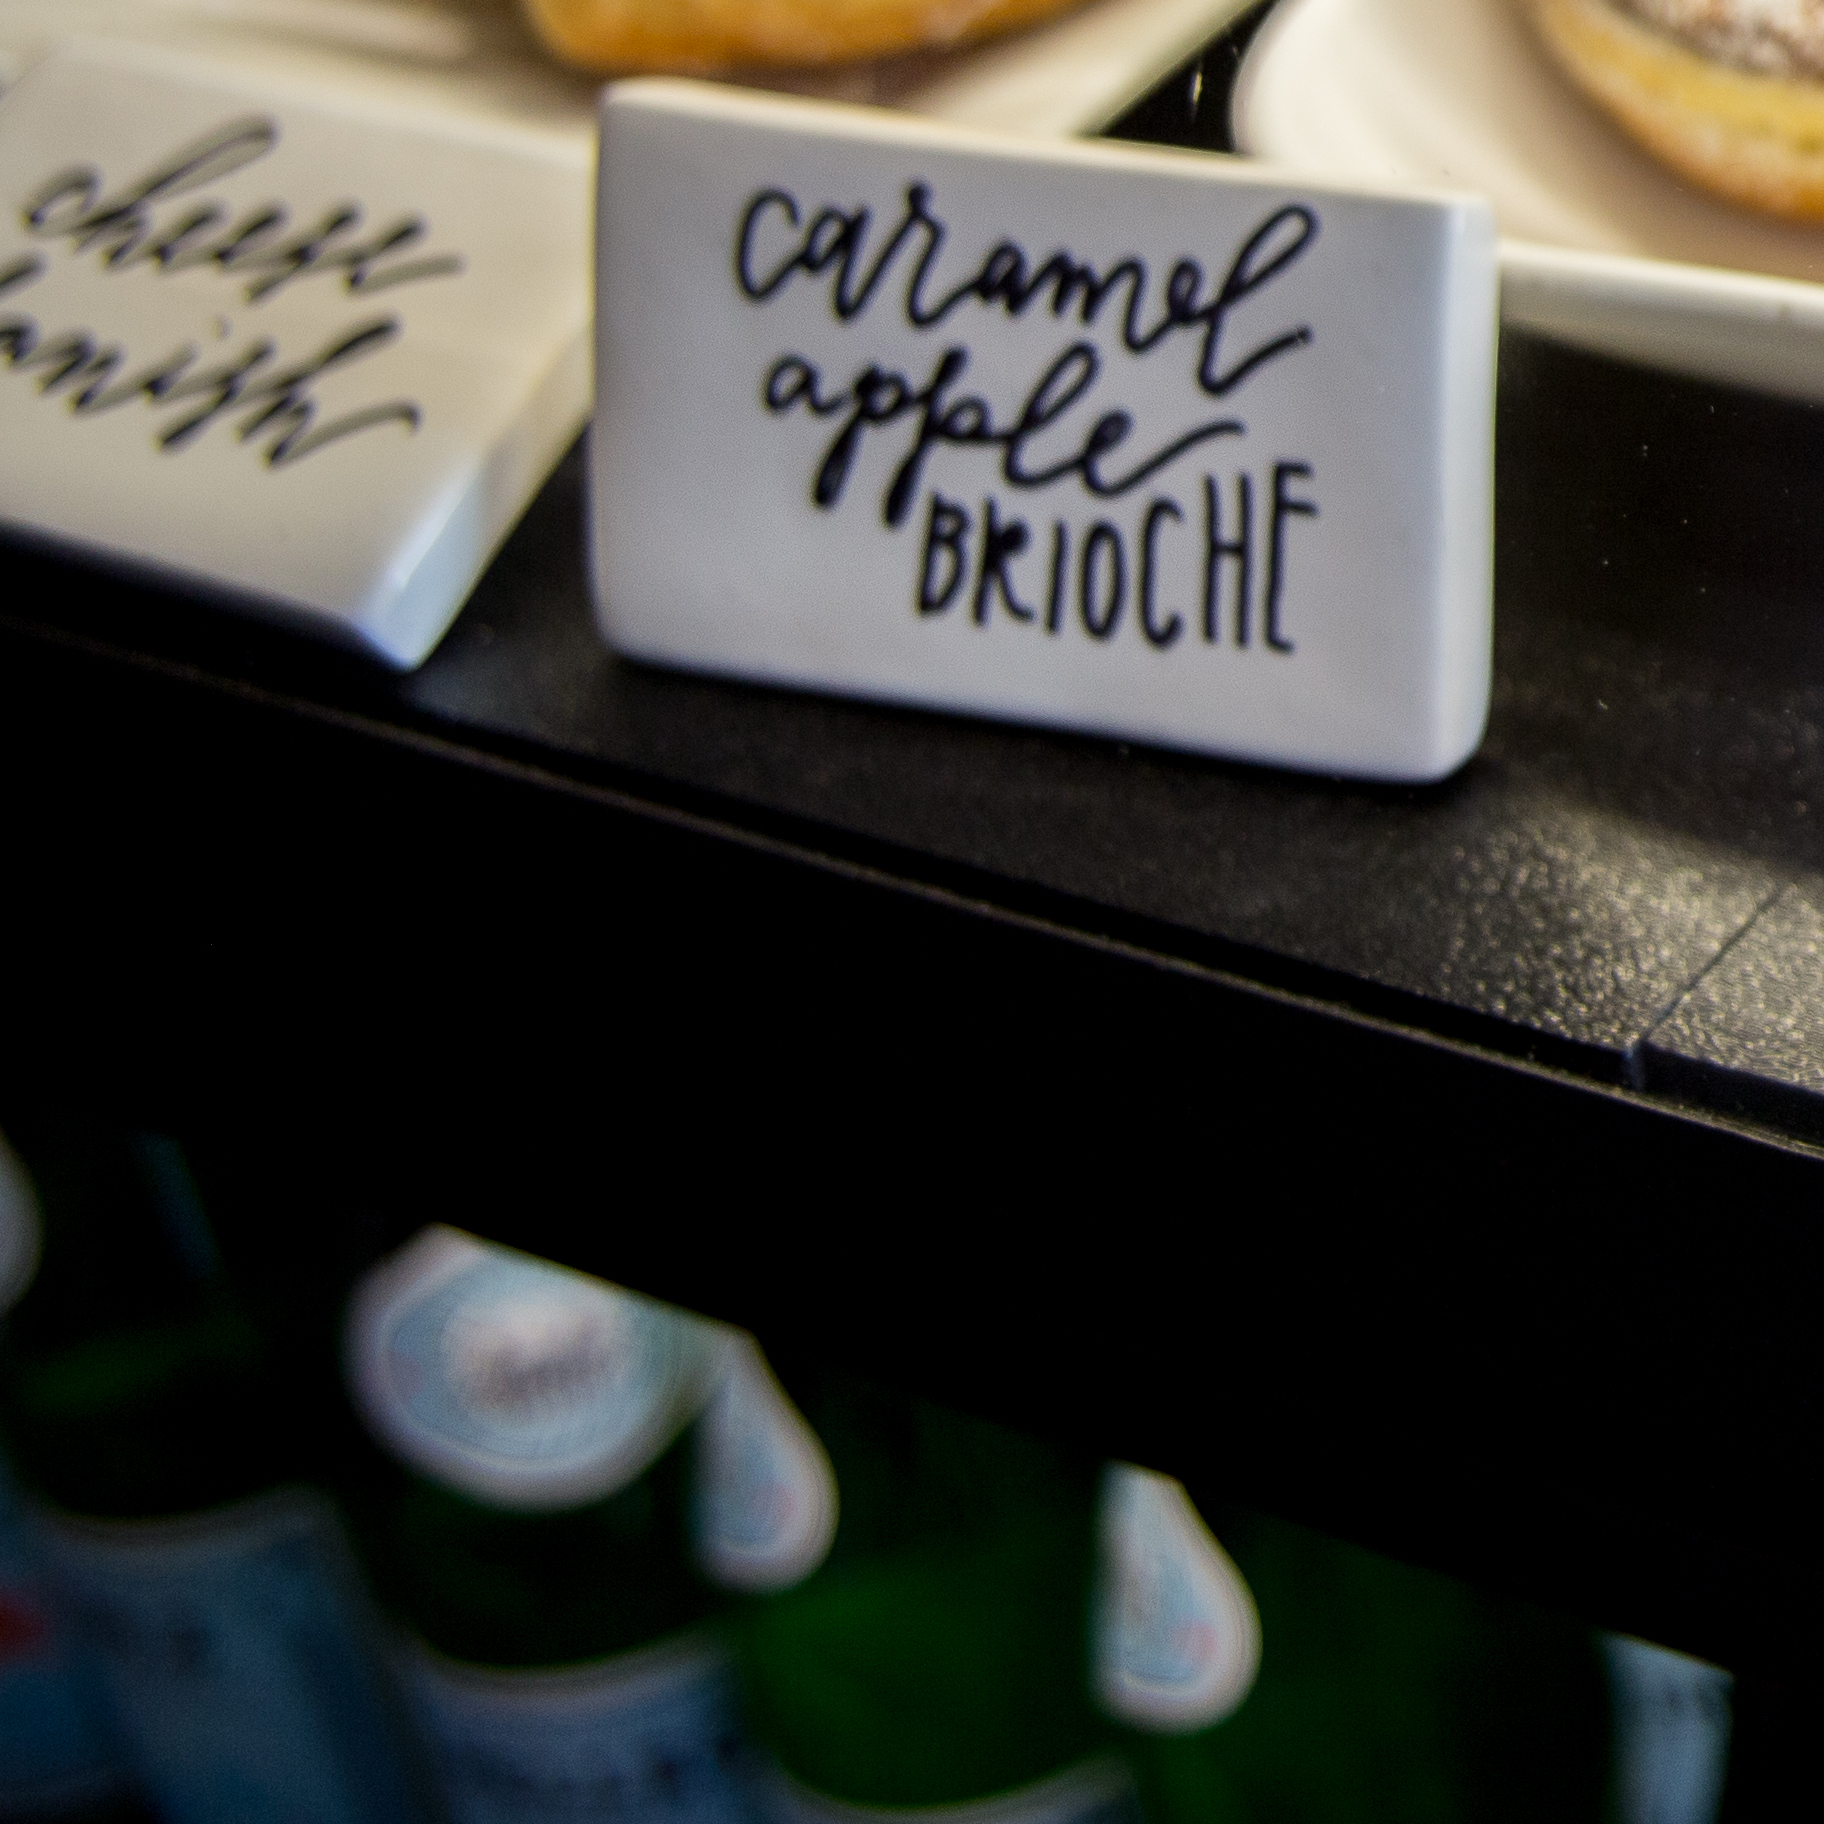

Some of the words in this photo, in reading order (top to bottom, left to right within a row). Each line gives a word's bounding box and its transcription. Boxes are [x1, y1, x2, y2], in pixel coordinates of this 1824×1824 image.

[22, 114, 464, 304] cheese
[736, 184, 1320, 398] caramel
[0, 254, 422, 468] anish
[762, 343, 1246, 530] apple
[913, 460, 1318, 655] BRIOCHE
